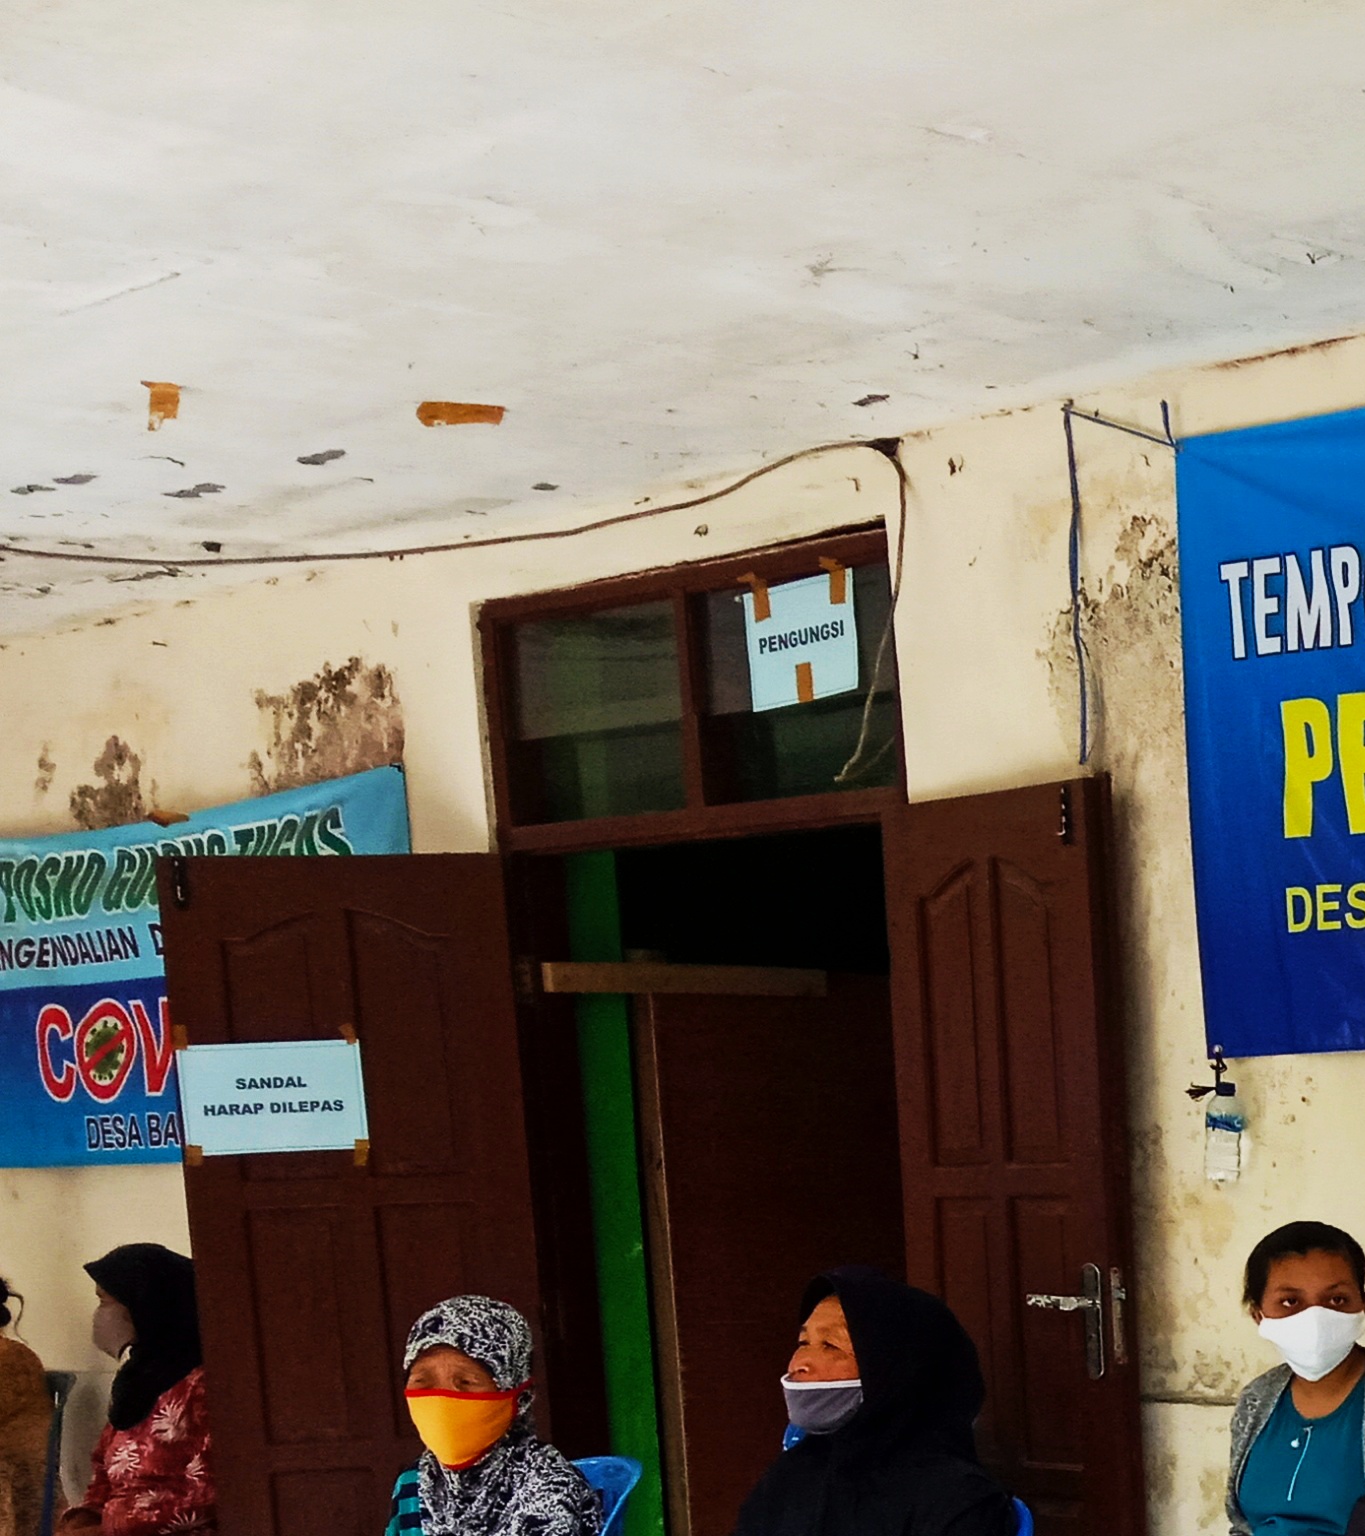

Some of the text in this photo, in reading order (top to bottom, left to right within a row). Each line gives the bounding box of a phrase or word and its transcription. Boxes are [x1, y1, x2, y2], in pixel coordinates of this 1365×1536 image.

[758, 620, 844, 654] PENGUNGSI
[0, 923, 140, 971] NGENDALIAN
[36, 997, 175, 1104] COV
[235, 1076, 307, 1090] SANDAL
[203, 1099, 344, 1116] HARAP DILEPAS
[86, 1112, 181, 1151] DESA BA
